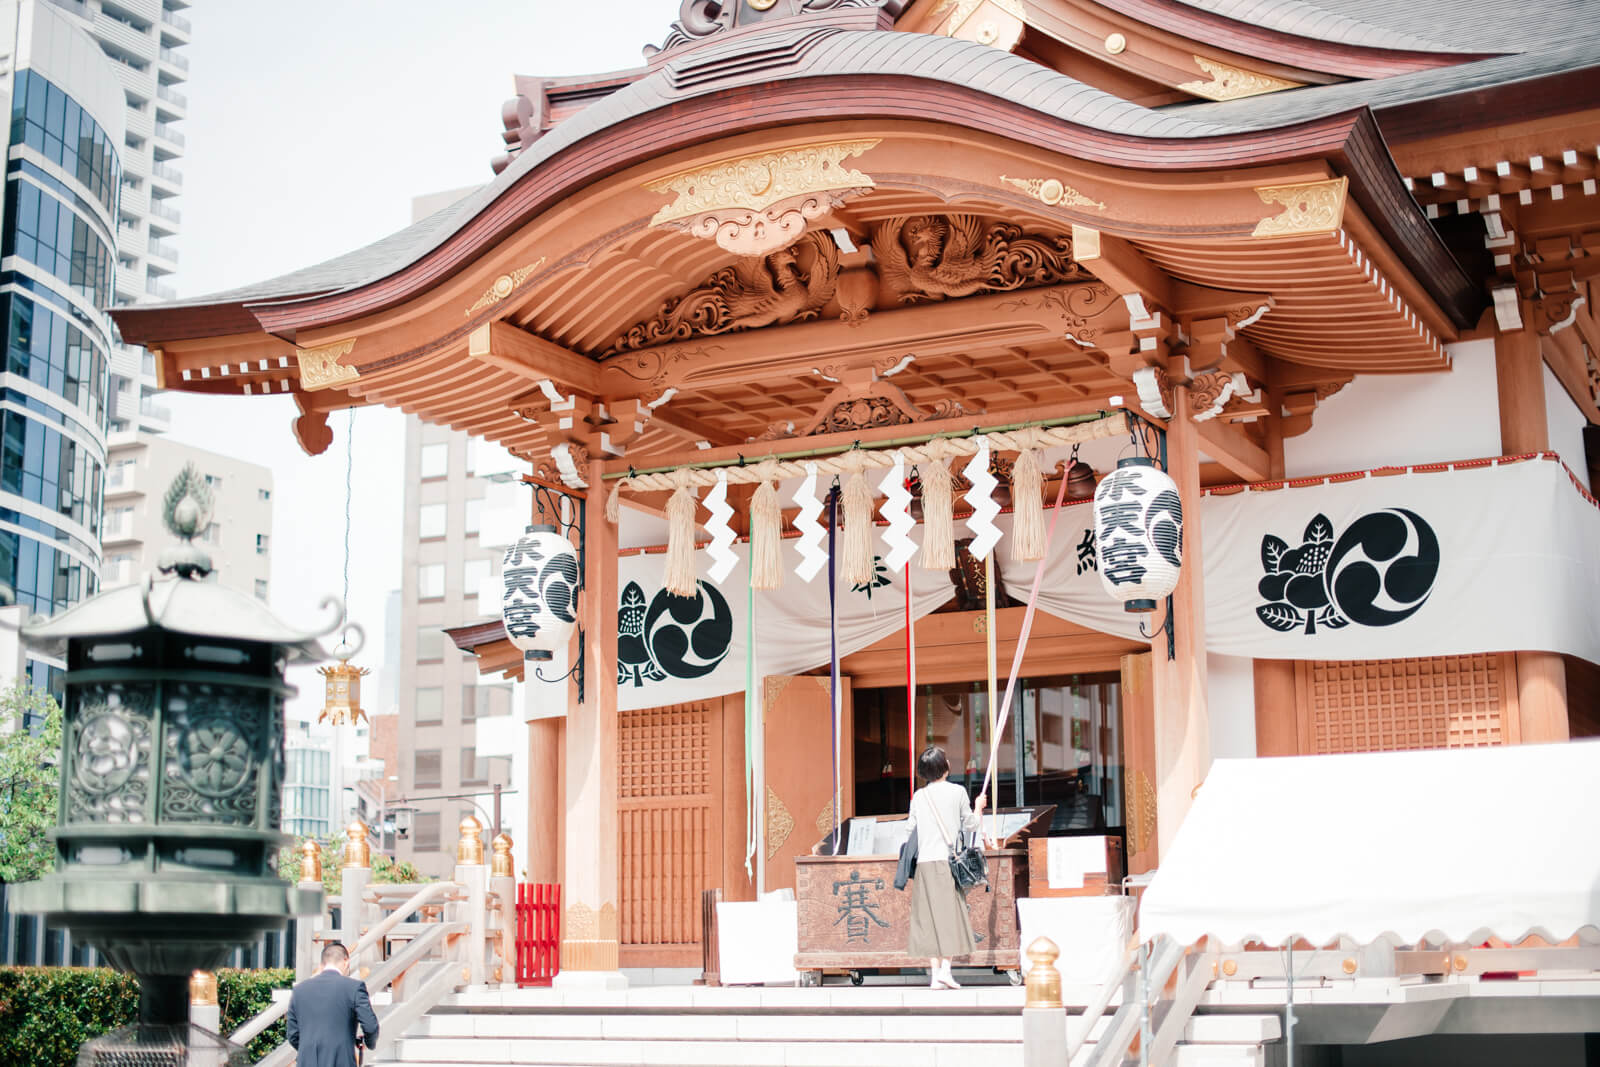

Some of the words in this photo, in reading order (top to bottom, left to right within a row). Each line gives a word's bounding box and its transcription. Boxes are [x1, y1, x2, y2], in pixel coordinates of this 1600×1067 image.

[1096, 470, 1149, 586] 水天宮
[503, 537, 545, 639] 水天宮
